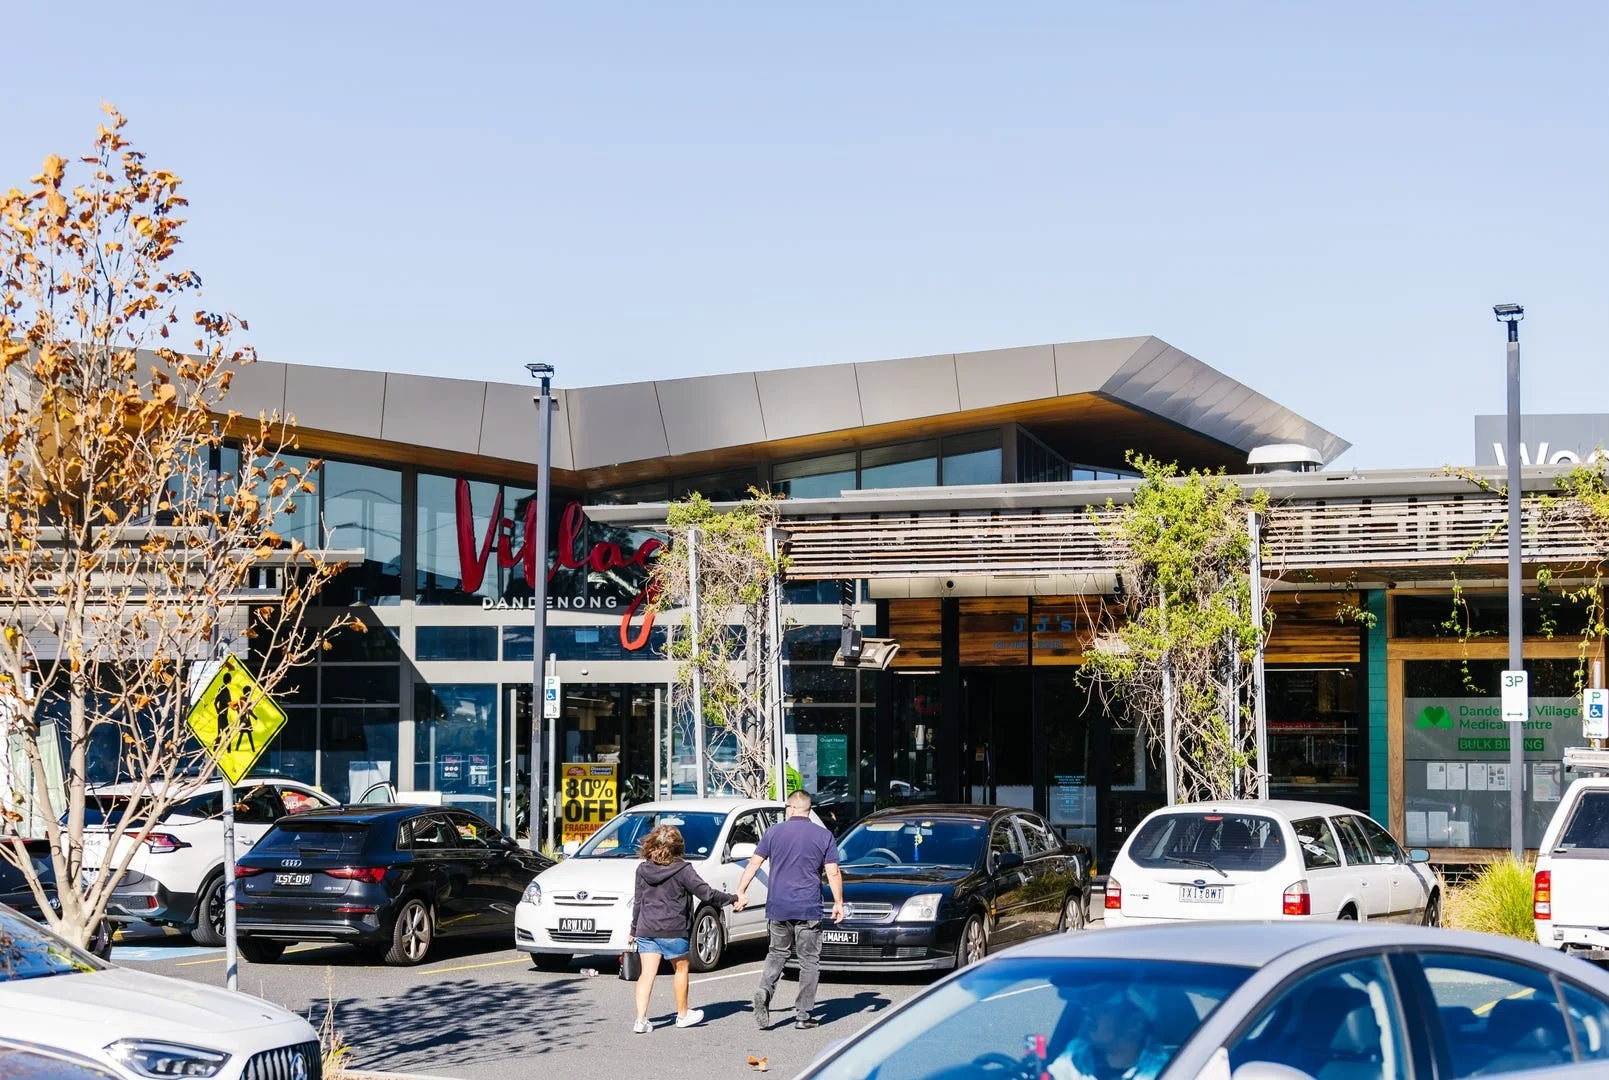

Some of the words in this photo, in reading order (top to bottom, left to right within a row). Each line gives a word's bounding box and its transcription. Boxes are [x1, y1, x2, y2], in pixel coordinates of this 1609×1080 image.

[456, 476, 669, 651] Villag
[482, 596, 617, 610] DANDENONG
[547, 678, 555, 688] P
[1505, 675, 1524, 687] 3P
[1592, 691, 1601, 702] P
[1459, 705, 1531, 718] Dande
[1535, 705, 1578, 718] Village
[1459, 719, 1507, 729] Medical
[1521, 720, 1552, 730] entre
[1459, 740, 1490, 749] BULK
[1494, 740, 1543, 749] BING
[566, 778, 613, 798] 80%
[565, 799, 613, 822] OFF
[564, 824, 603, 832] FRAGRAN
[561, 919, 593, 931] ARWIND
